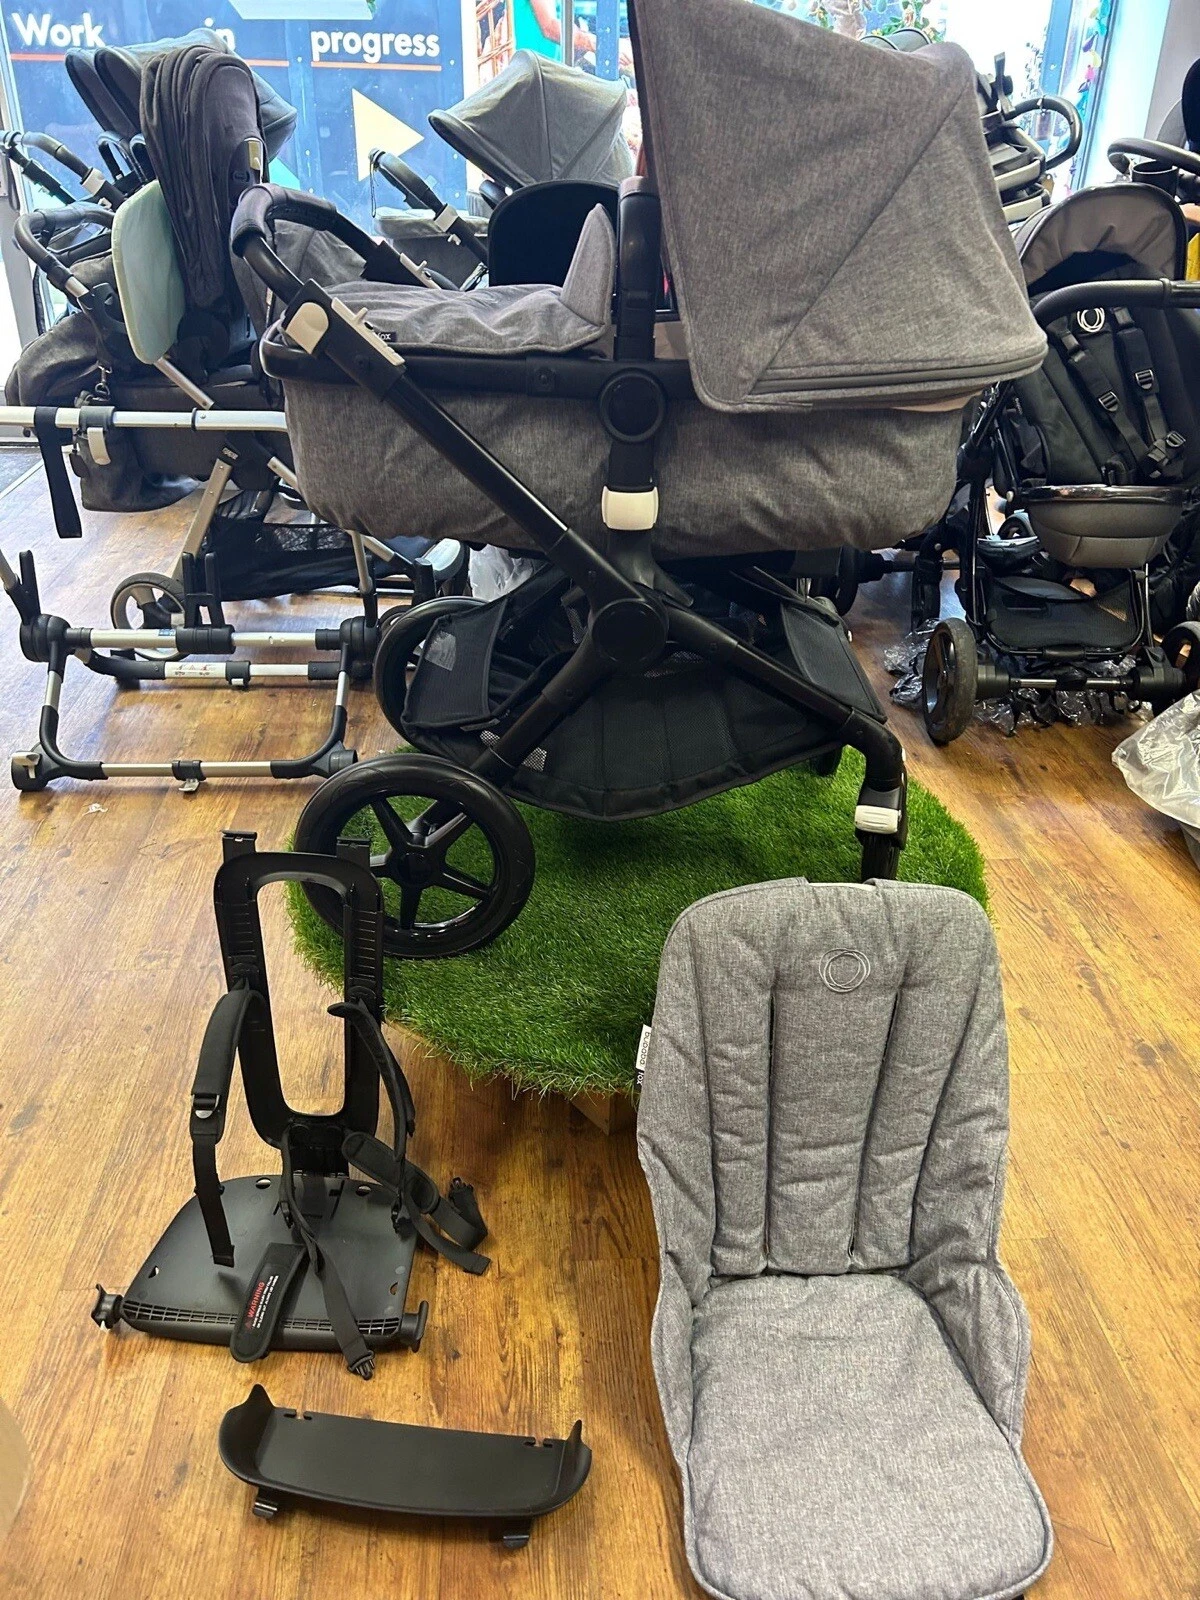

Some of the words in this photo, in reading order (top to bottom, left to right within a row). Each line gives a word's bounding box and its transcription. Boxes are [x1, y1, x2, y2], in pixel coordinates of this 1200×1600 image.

[11, 12, 106, 48] Work
[204, 17, 236, 51] n
[310, 29, 440, 64] progress
[247, 1281, 265, 1318] WARNING
